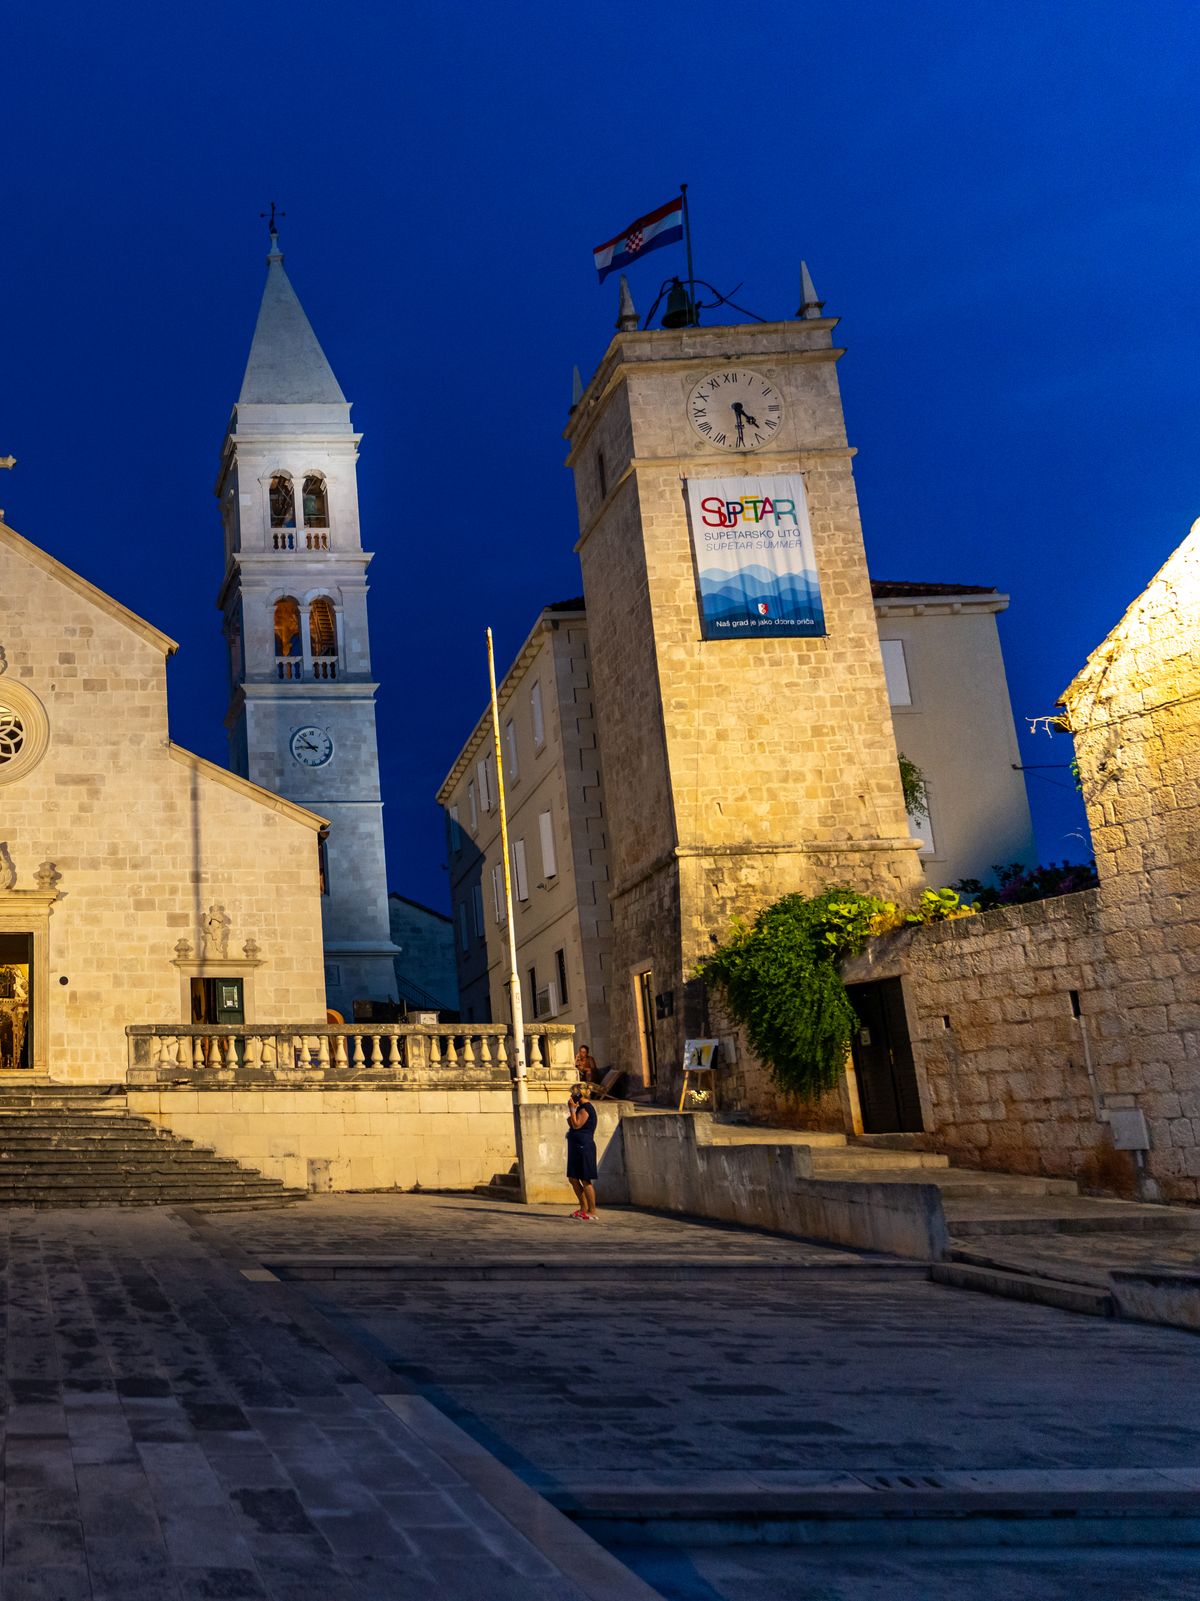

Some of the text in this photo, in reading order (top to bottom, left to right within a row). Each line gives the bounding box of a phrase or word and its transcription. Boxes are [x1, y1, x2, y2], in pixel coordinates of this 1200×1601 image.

[723, 373, 737, 383] XII
[701, 495, 798, 528] SUPETAR
[704, 528, 800, 541] SUPETARSKO LITO
[706, 540, 802, 552] SUPETAR SUMMER
[716, 619, 730, 628] Naš
[732, 619, 748, 628] grad
[750, 619, 756, 627] je
[758, 618, 772, 627] jako
